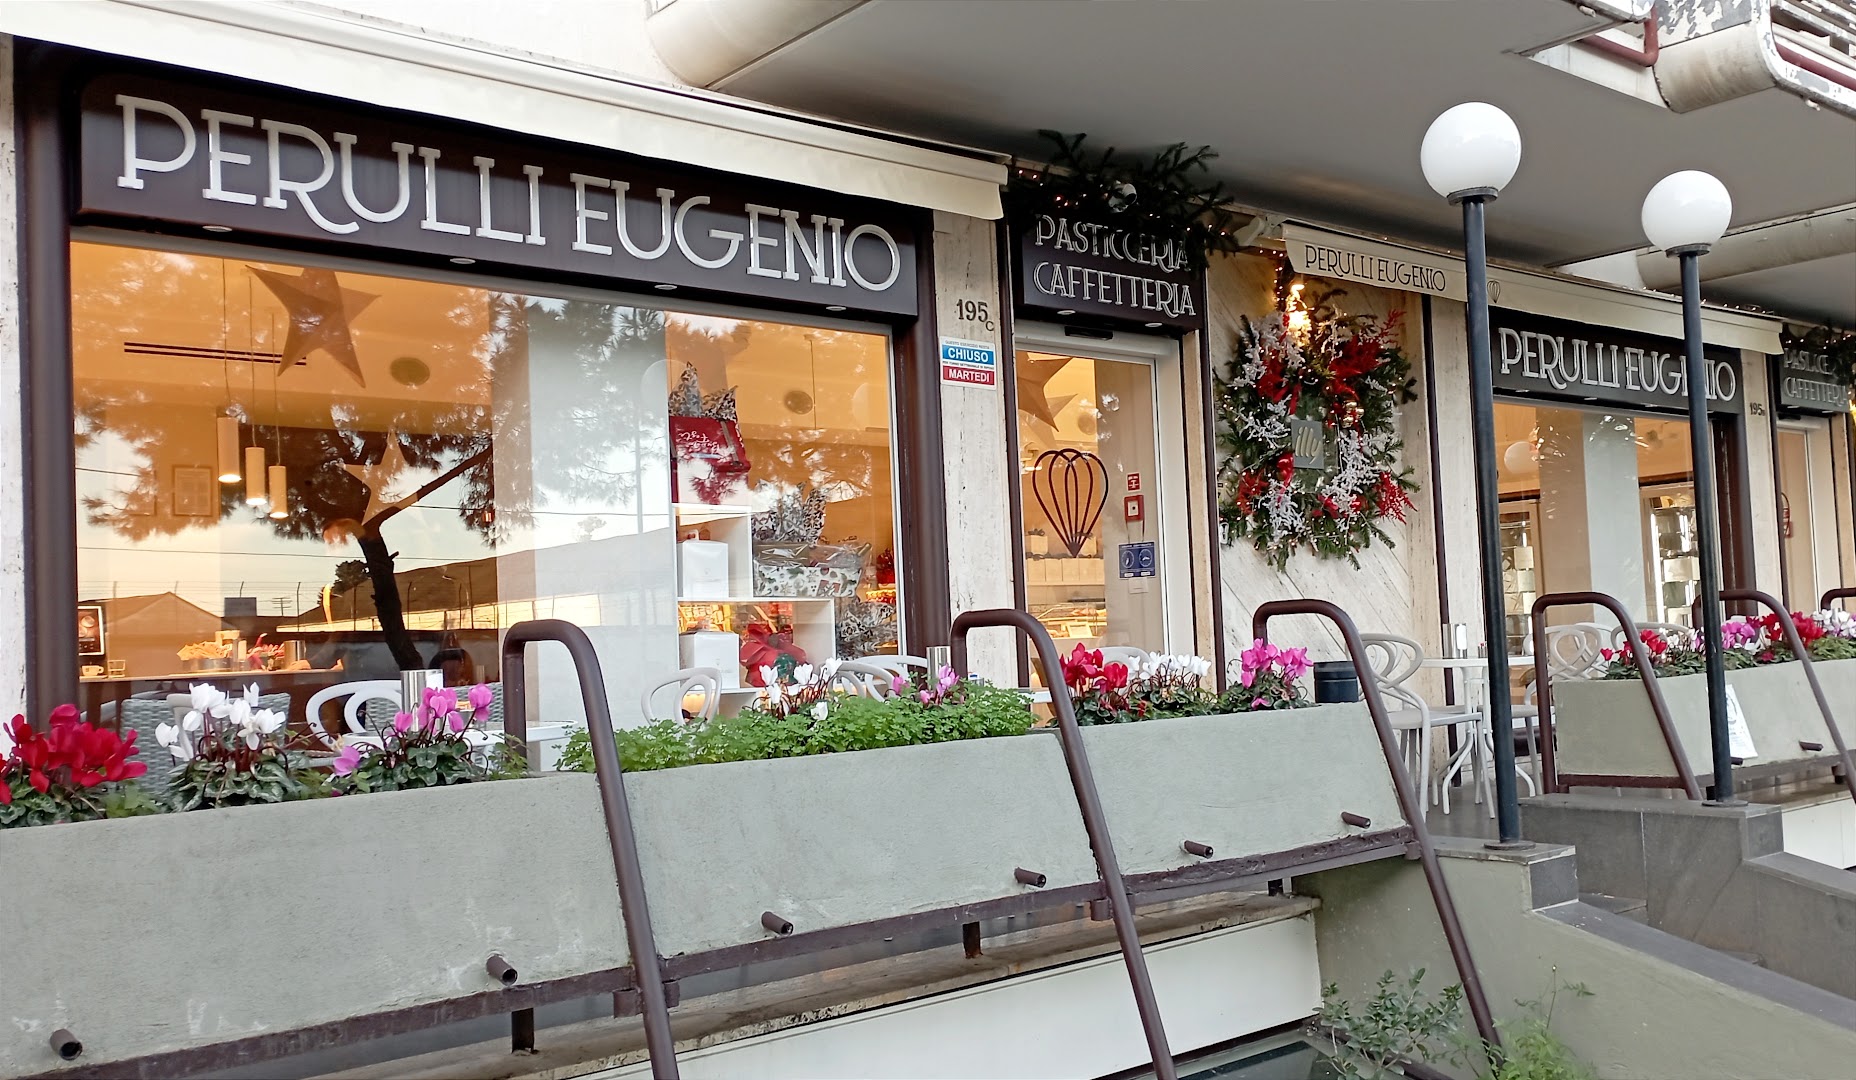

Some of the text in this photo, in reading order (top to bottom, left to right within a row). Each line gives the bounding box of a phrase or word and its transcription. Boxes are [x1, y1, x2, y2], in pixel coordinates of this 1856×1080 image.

[115, 93, 901, 292] PERULLI EUGENIO
[1033, 262, 1196, 318] CAFFETTERIA
[1305, 244, 1446, 292] PERULLI EUGENIO
[948, 347, 988, 362] CHIUSO
[949, 368, 989, 382] MARTEDI
[1498, 327, 1737, 402] PERULLI EUGIO
[1295, 426, 1322, 465] illy
